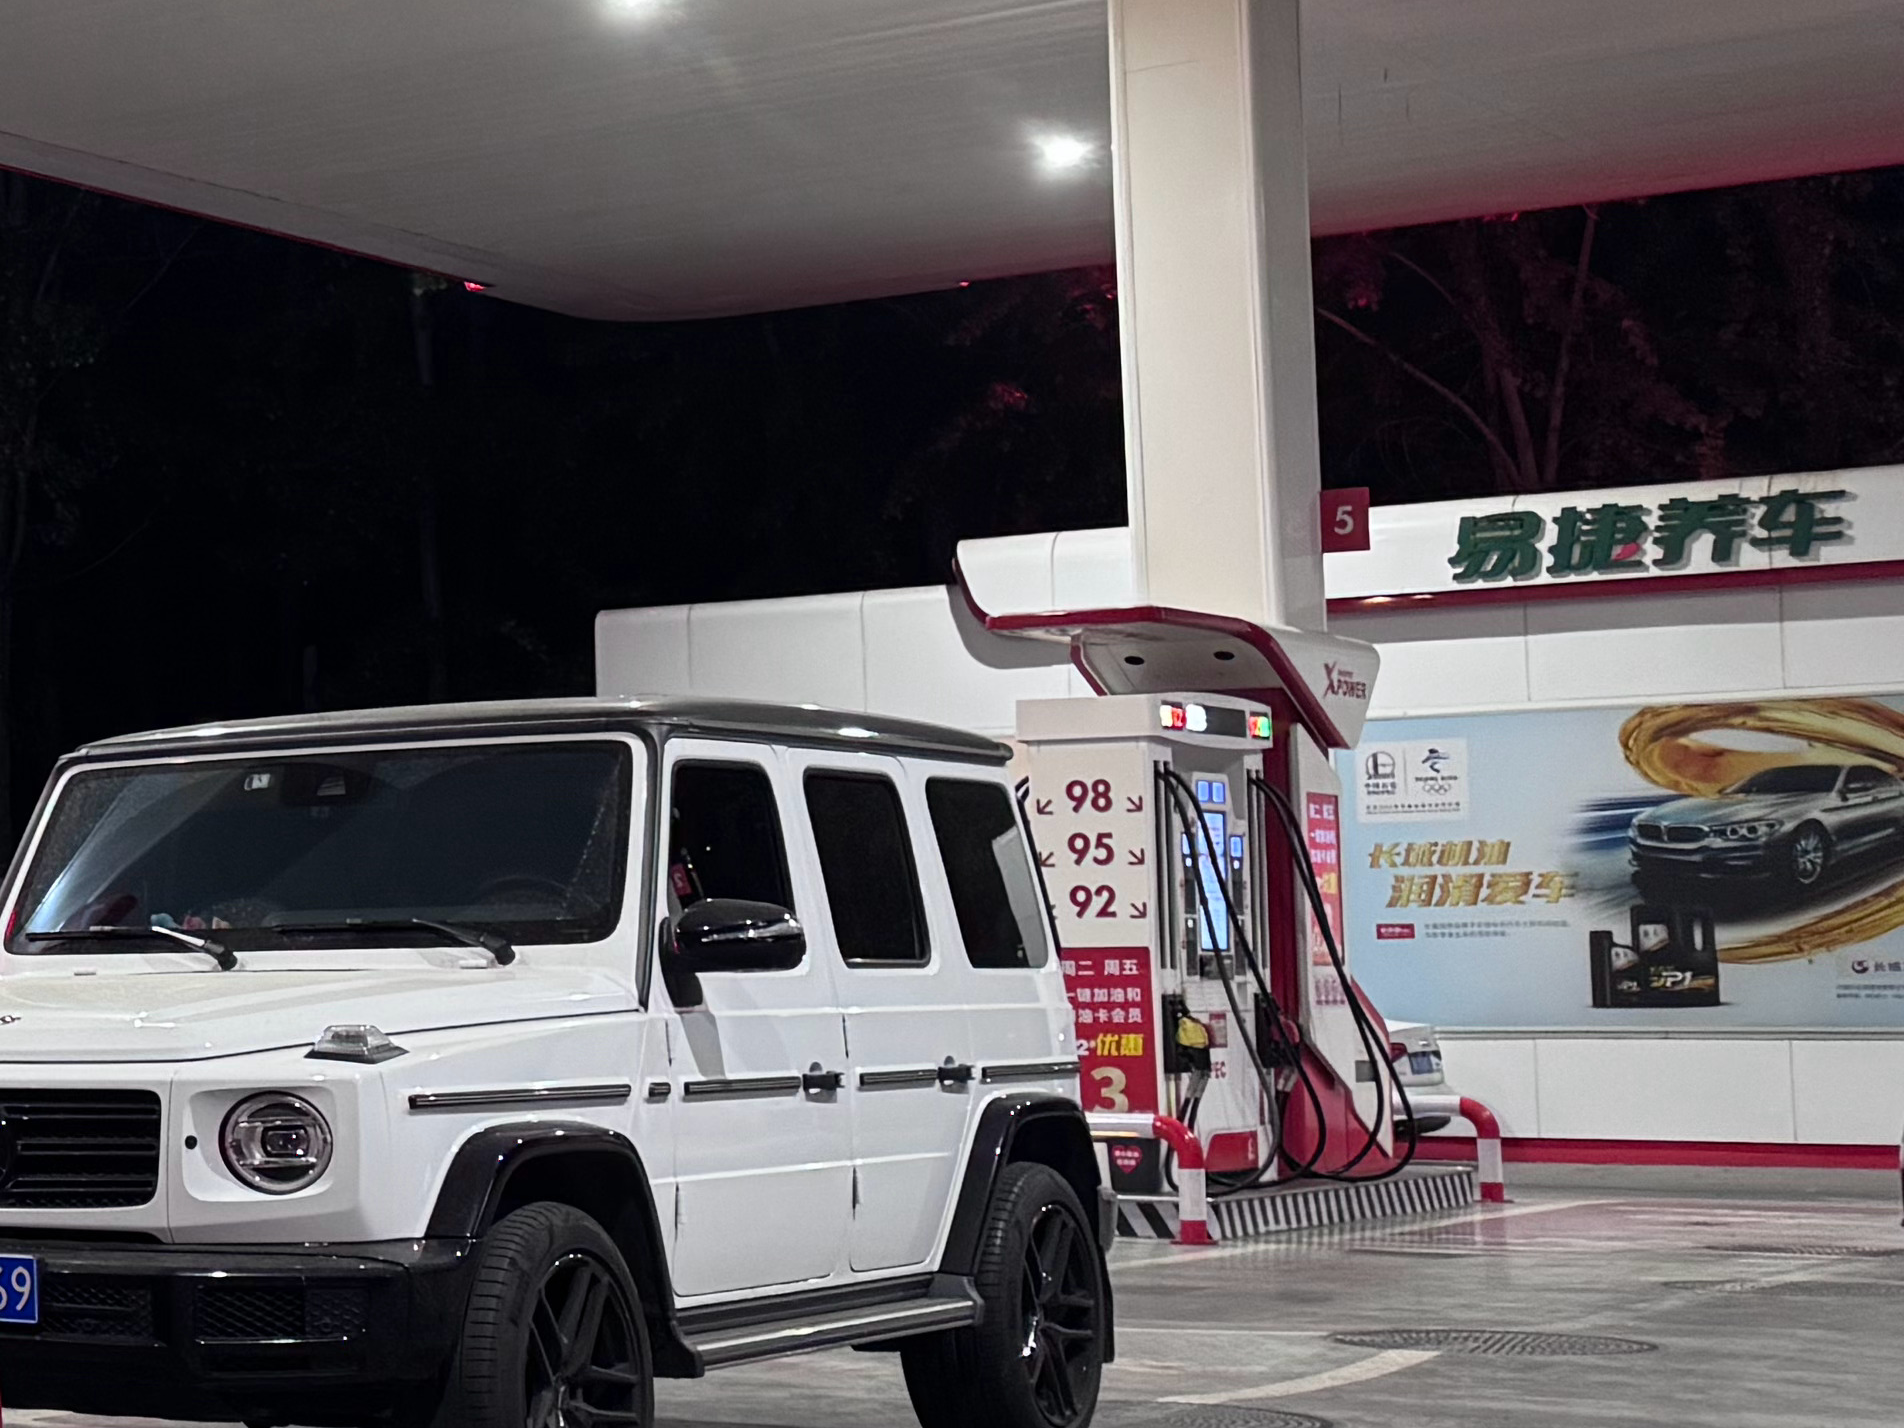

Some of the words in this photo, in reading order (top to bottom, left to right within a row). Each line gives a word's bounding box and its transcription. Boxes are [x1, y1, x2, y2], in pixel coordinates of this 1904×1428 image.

[1333, 505, 1355, 536] 5
[1447, 488, 1848, 583] 易捷养车
[1064, 778, 1114, 815] 98
[1066, 831, 1115, 867] 95
[1068, 884, 1118, 920] 92
[1385, 870, 1578, 909] 润滑爱车
[1103, 959, 1139, 976] 周五
[1073, 1008, 1143, 1024] 油卡会员
[1096, 1033, 1145, 1057] 优惠
[1090, 1066, 1130, 1112] 3
